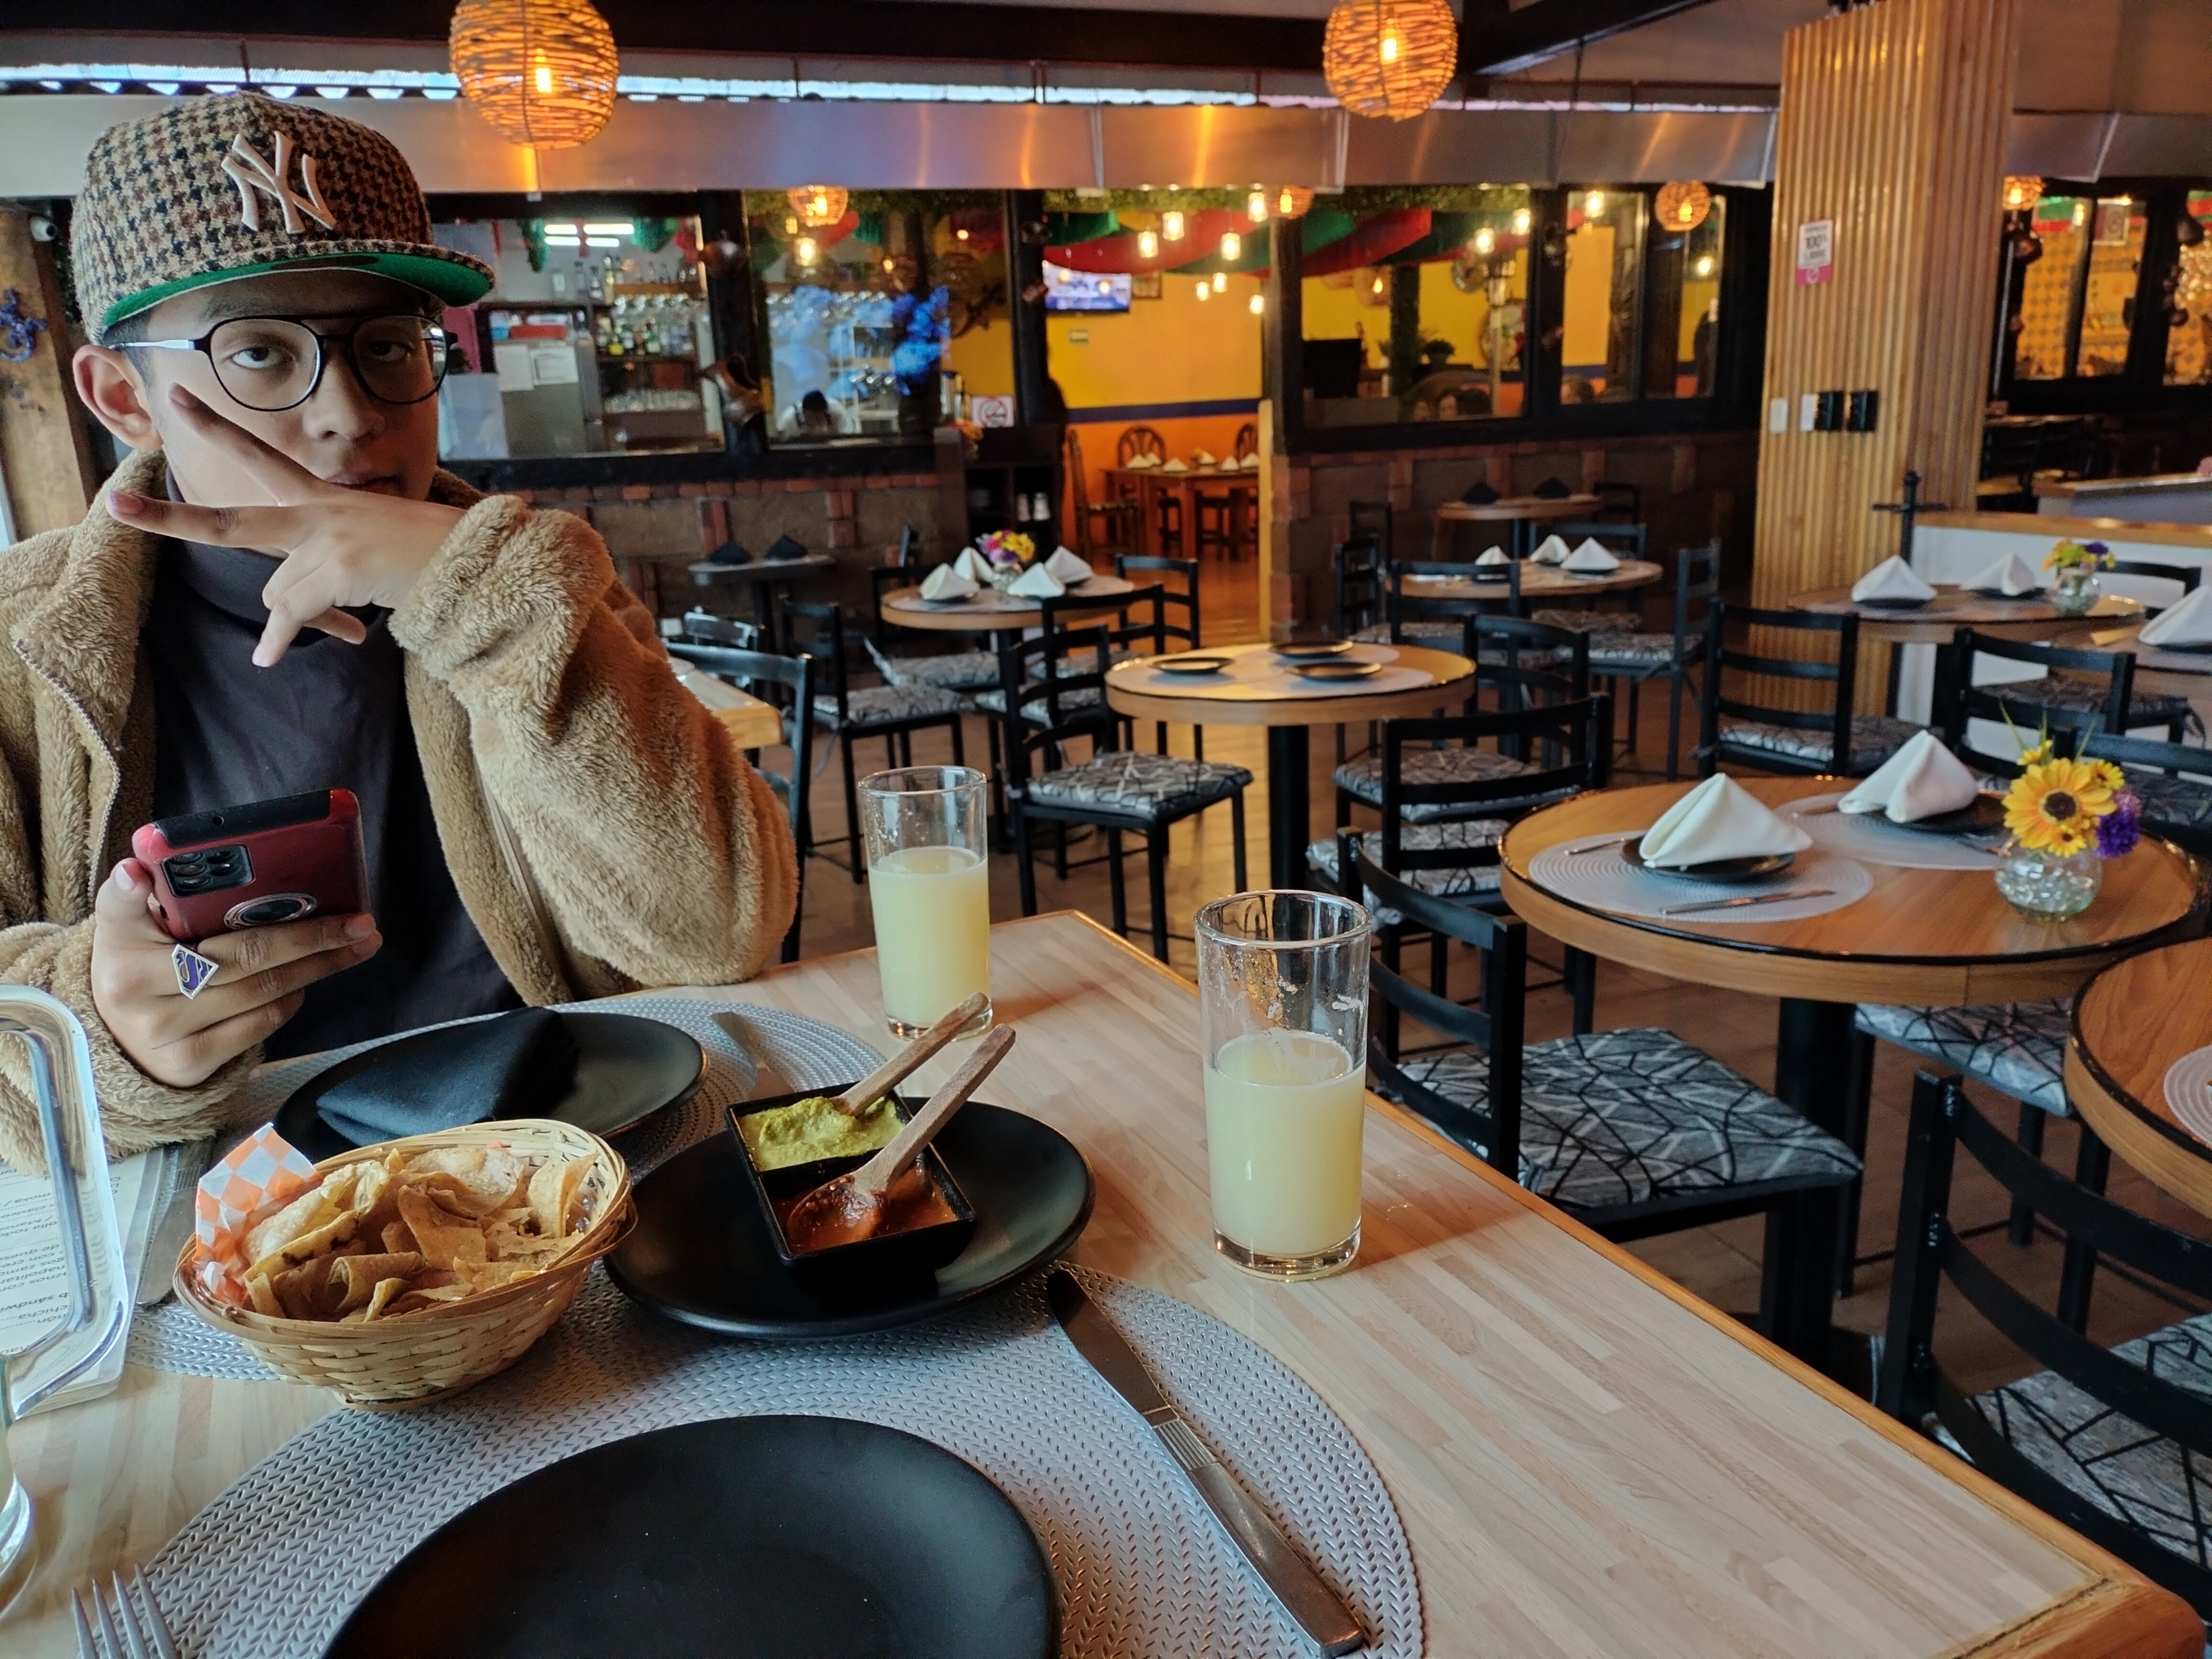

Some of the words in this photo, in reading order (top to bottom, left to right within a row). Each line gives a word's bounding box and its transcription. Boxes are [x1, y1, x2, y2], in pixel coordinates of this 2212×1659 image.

[221, 130, 337, 234] NY
[15, 1193, 51, 1203] moka
[29, 1252, 54, 1261] con
